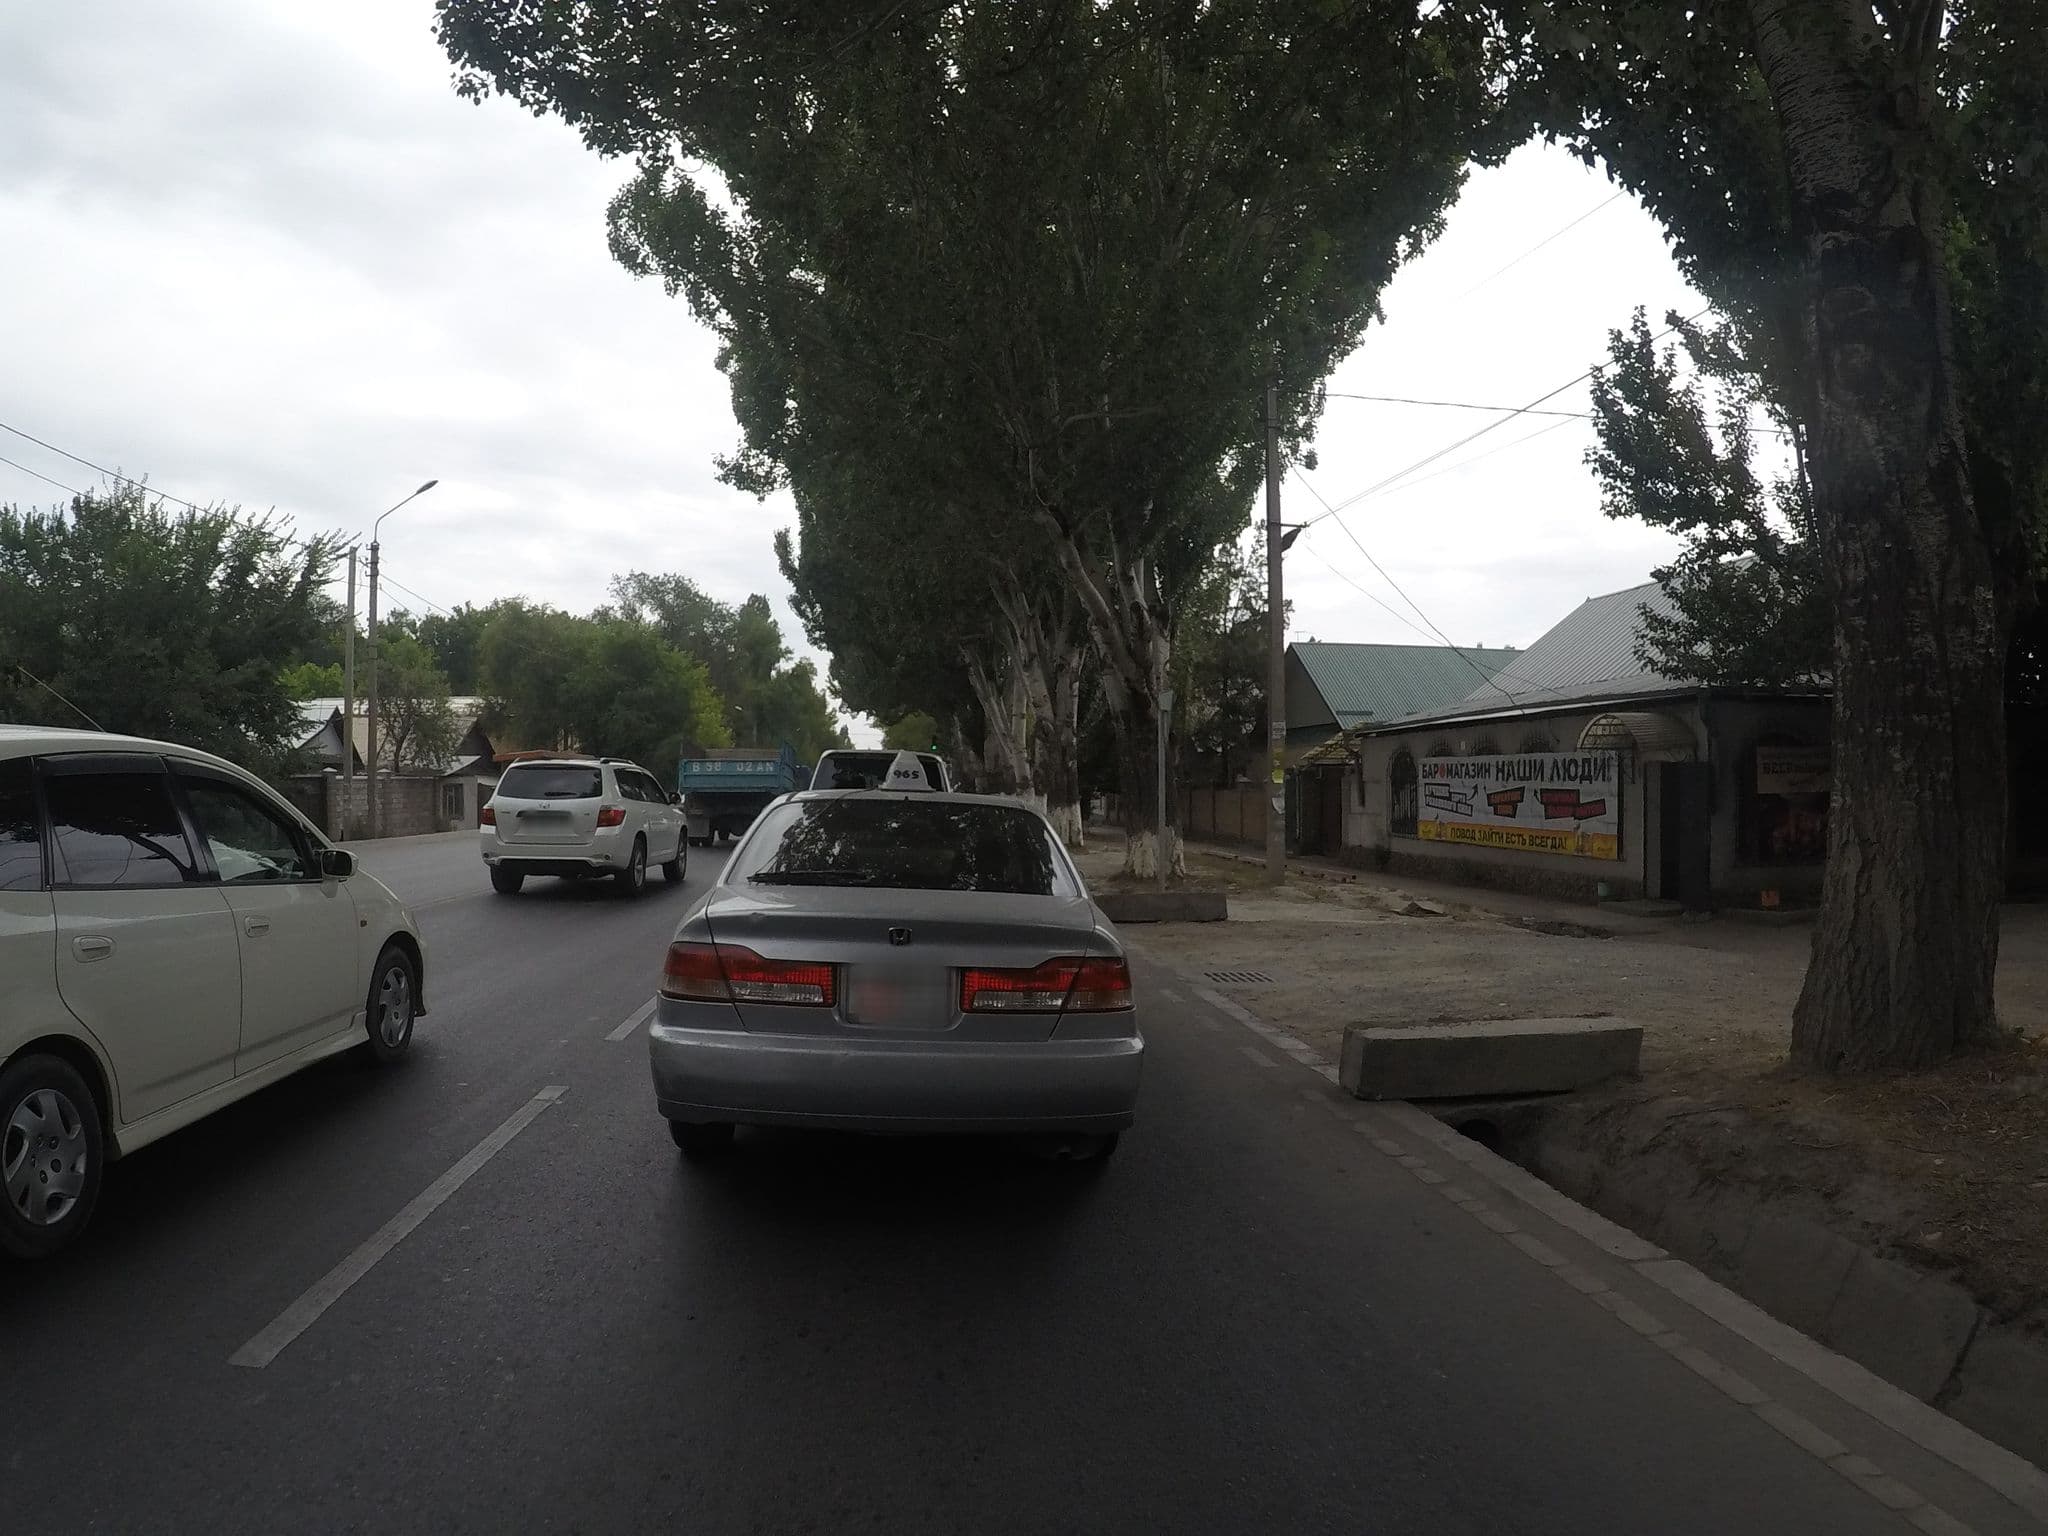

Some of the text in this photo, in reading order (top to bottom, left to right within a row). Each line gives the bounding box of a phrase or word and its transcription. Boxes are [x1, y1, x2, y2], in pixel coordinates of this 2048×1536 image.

[1496, 759, 1544, 782] НАШИ
[1450, 827, 1476, 841] ПОВОД
[1477, 828, 1504, 843] ЗАЙТИ
[1505, 831, 1526, 846] ЕСТЬ
